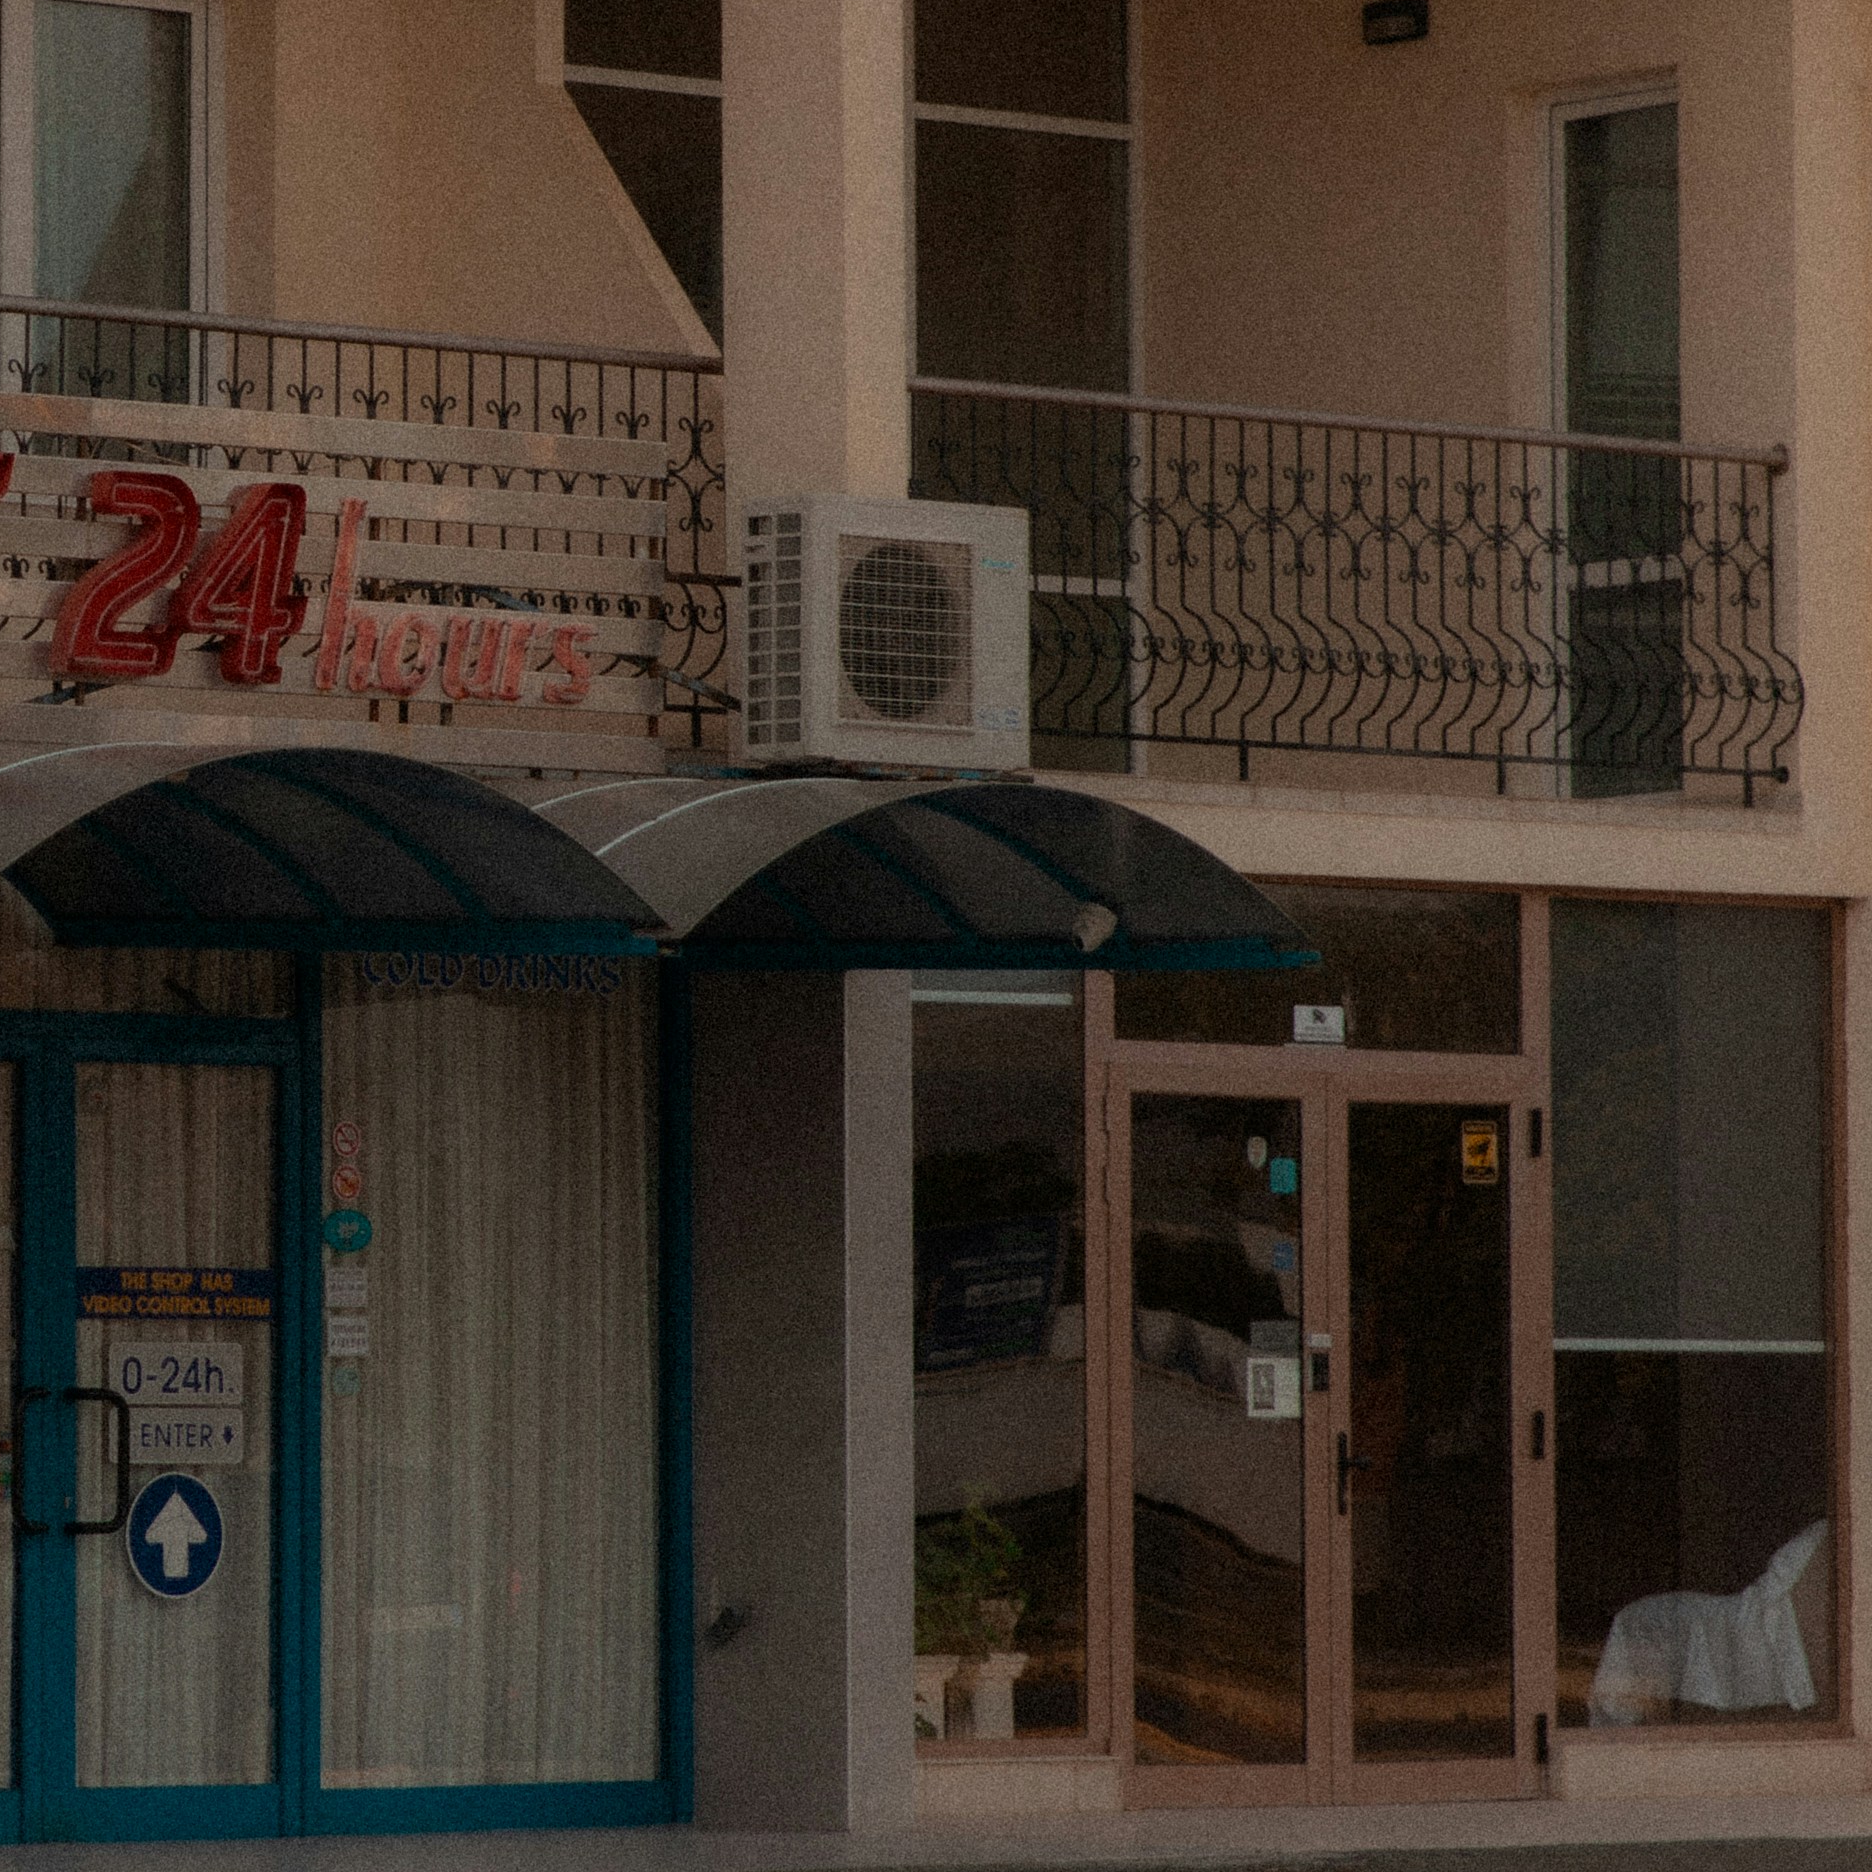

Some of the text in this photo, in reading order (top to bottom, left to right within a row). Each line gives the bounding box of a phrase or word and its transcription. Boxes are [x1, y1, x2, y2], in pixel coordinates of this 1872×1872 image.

[54, 468, 309, 686] 24
[315, 496, 599, 705] hours
[362, 950, 622, 995] COLD DRINKS
[120, 1271, 234, 1293] THE SHOP HAS
[82, 1294, 271, 1317] VIDEO CONTROL SYSTEM
[140, 1422, 215, 1449] ENTER
